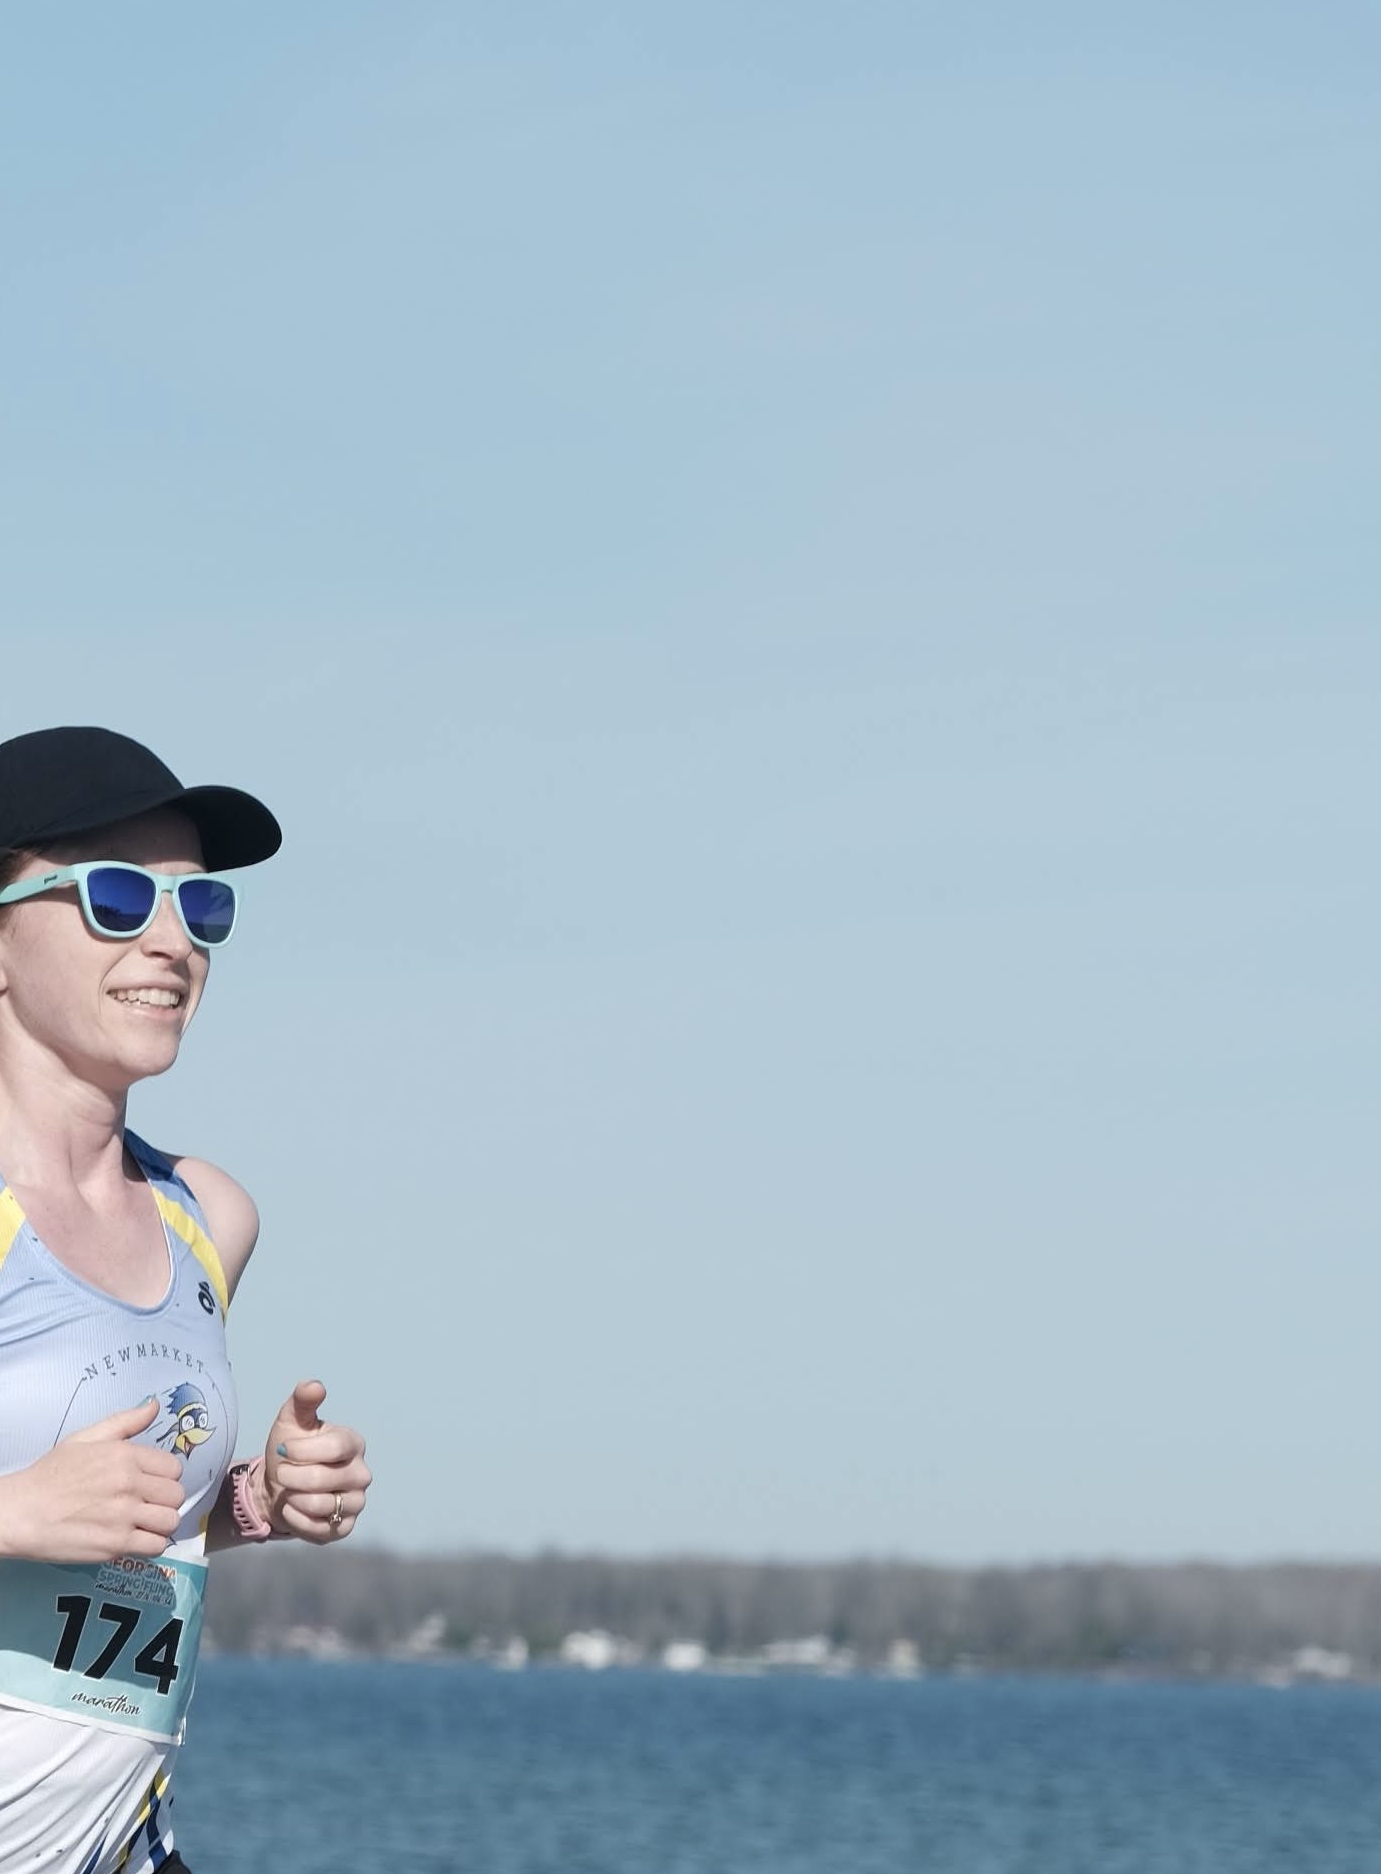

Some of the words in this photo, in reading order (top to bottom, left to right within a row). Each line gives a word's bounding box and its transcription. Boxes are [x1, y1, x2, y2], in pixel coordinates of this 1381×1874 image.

[84, 1344, 204, 1380] NEWMARKET
[98, 1570, 143, 1590] SPRING
[51, 1594, 185, 1695] 174
[71, 1692, 141, 1715] marathon
